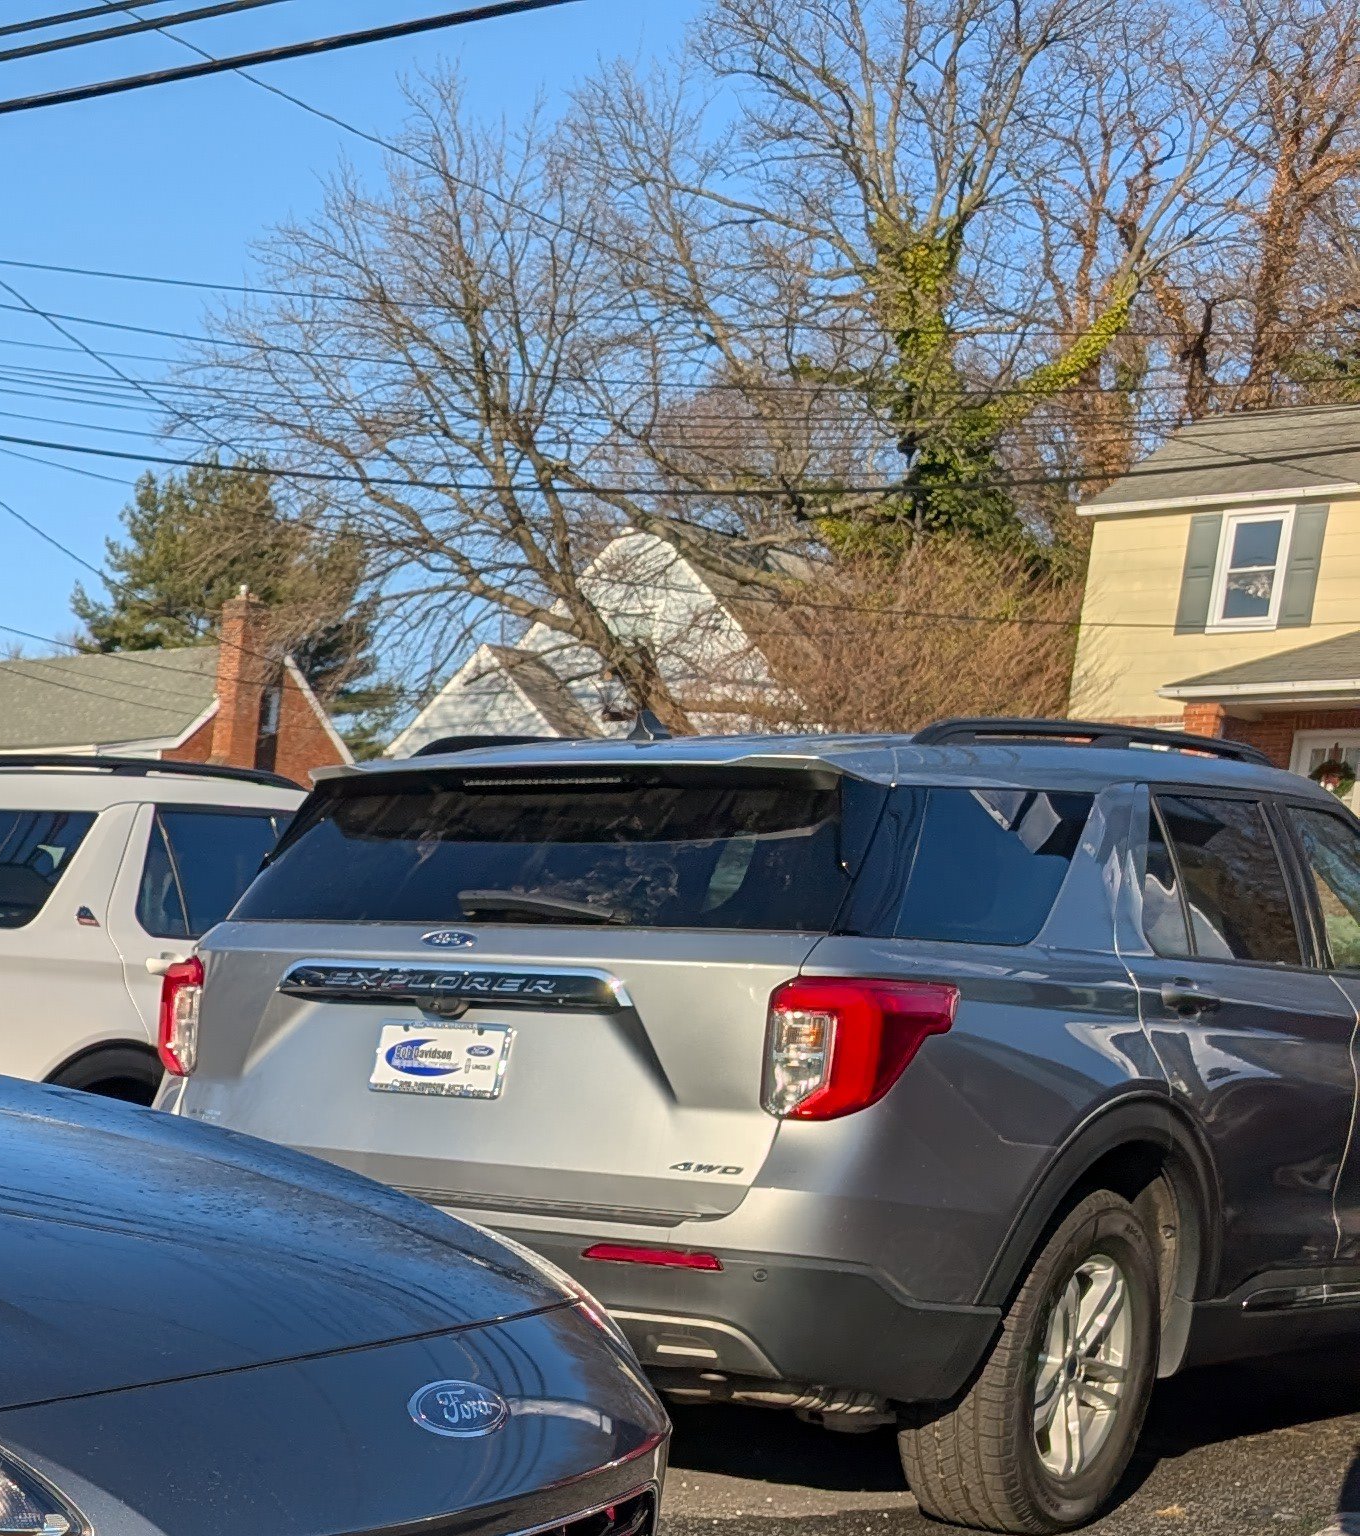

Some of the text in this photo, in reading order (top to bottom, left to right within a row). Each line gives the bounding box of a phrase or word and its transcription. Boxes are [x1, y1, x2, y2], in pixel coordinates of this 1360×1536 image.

[325, 970, 557, 995] EXPLORER
[414, 1045, 453, 1061] Davidson
[668, 1161, 744, 1175] 4WD
